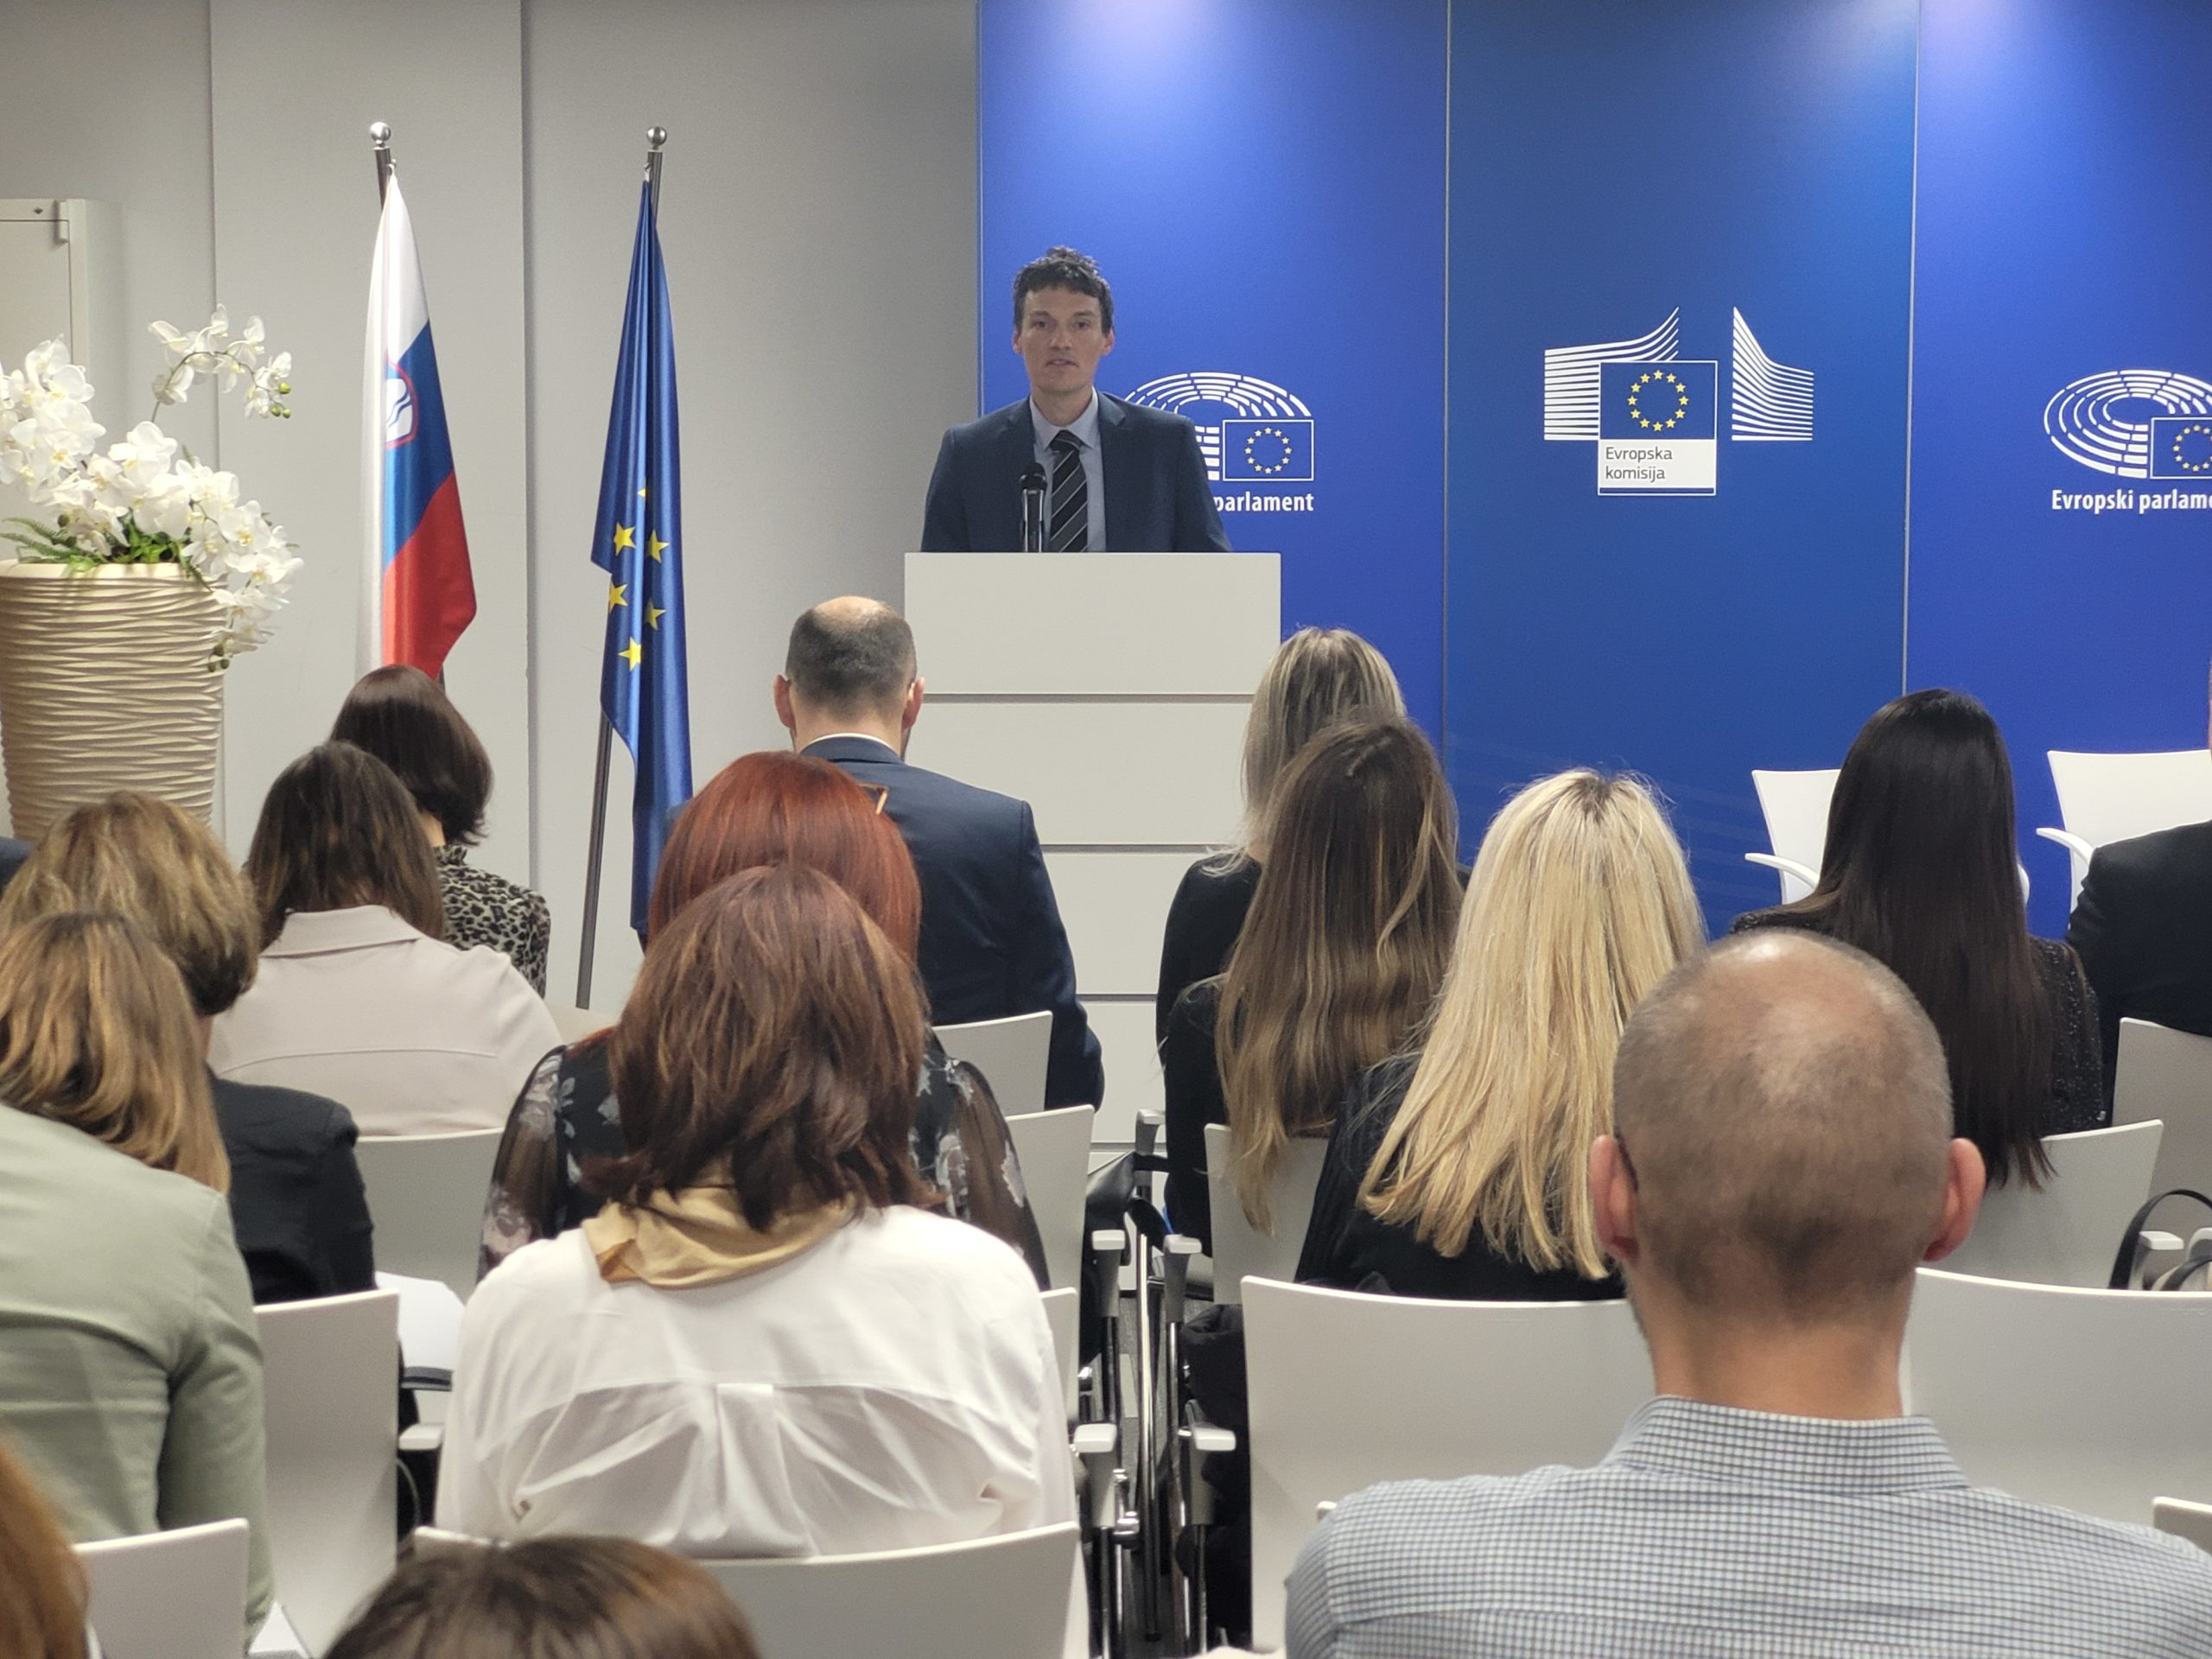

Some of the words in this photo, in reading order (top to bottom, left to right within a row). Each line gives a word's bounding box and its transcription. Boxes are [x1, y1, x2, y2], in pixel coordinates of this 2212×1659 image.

[1605, 446, 1673, 462] Evropska
[1605, 465, 1666, 482] komisija
[2051, 488, 2133, 515] Evropski
